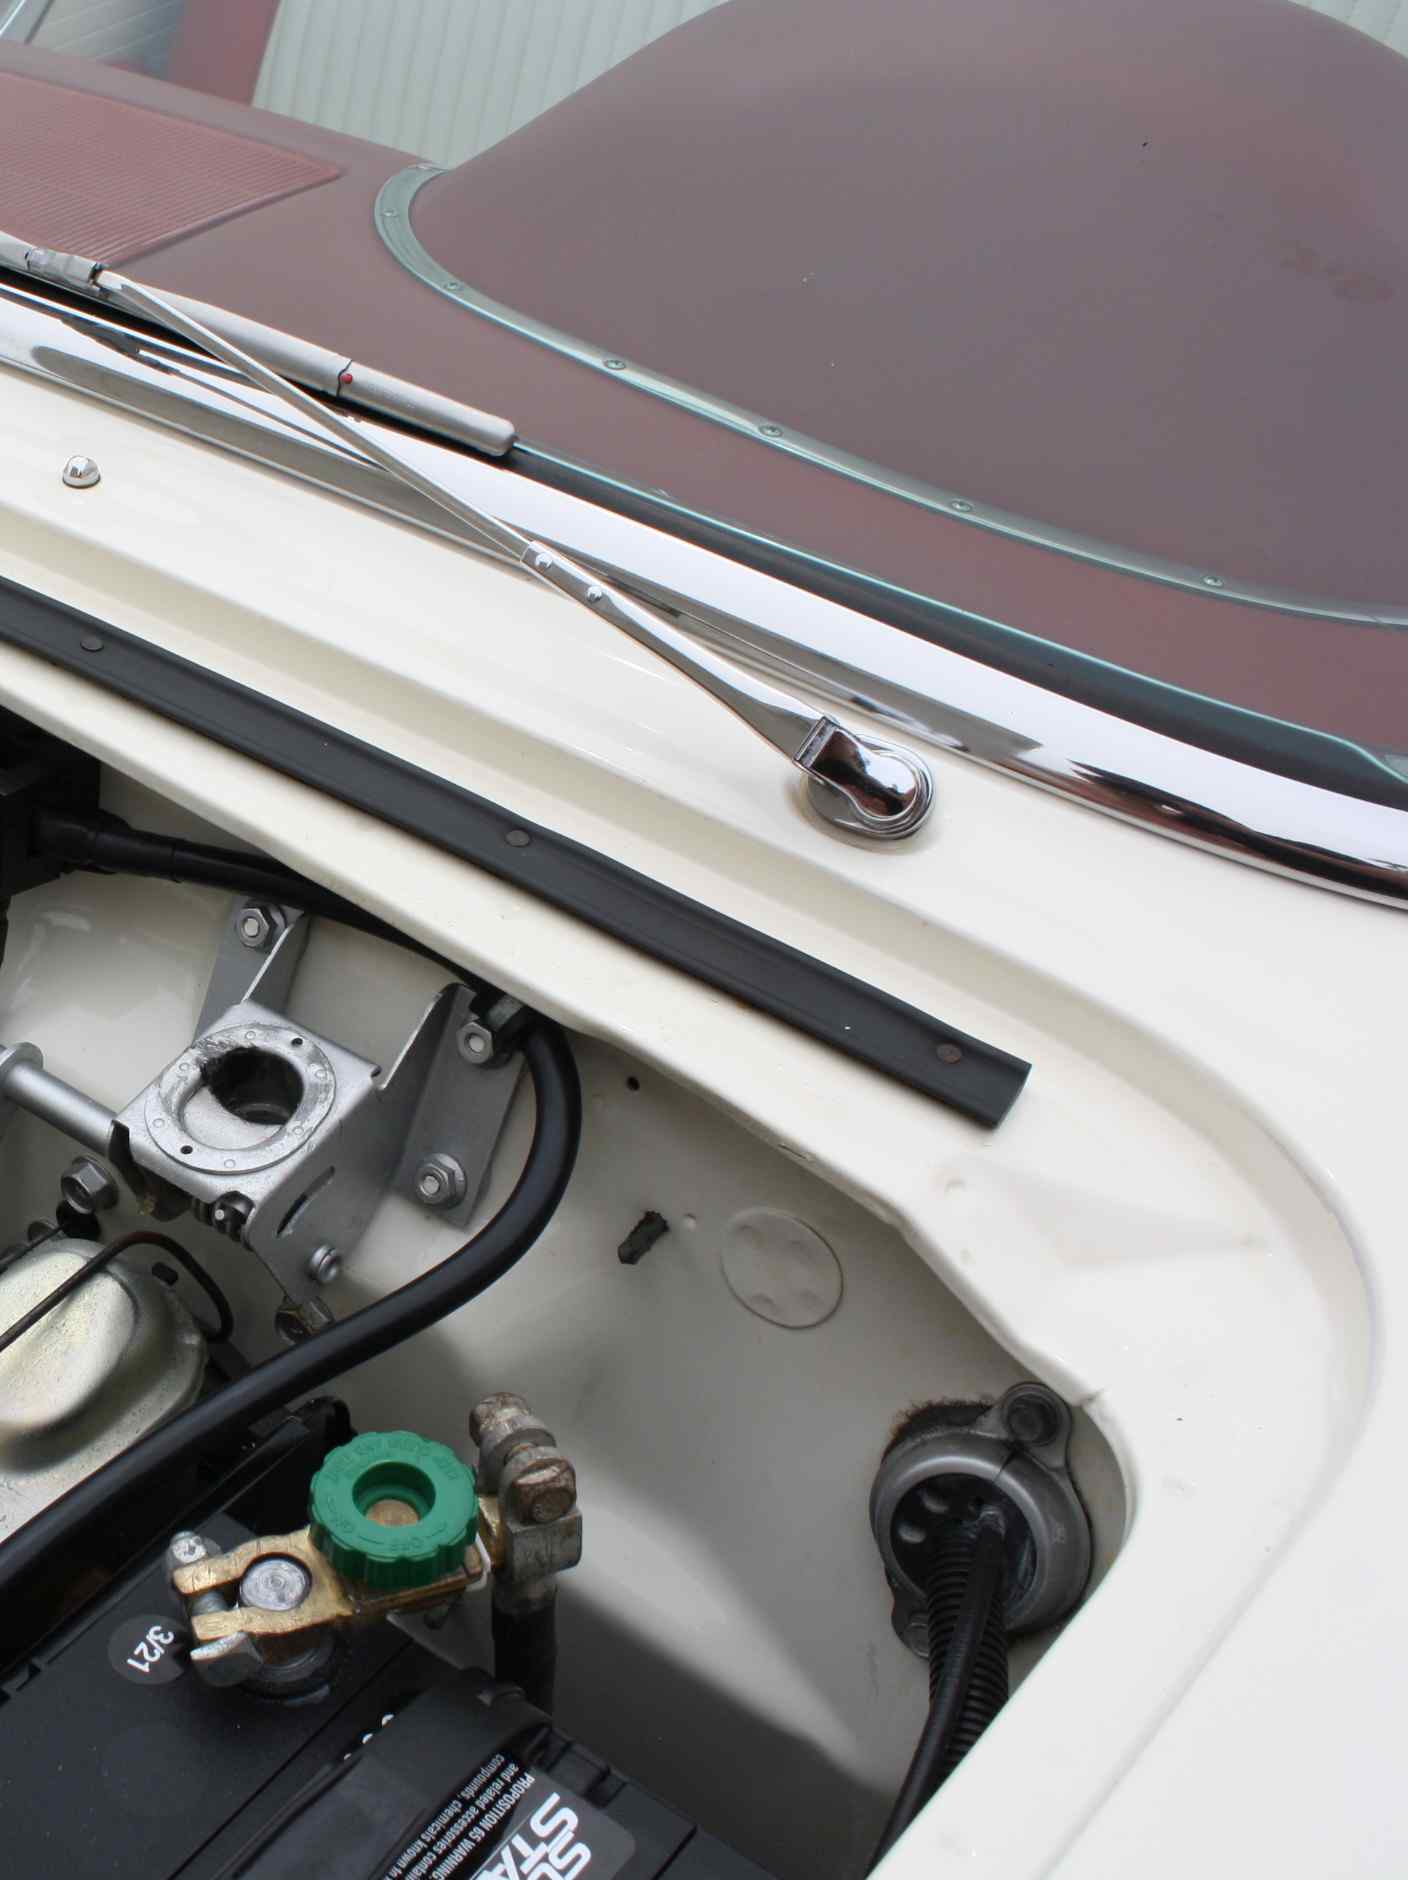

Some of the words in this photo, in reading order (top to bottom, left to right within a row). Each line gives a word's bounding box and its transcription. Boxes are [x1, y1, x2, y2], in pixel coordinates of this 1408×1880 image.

[126, 1625, 174, 1672] 3/21
[500, 1763, 519, 1783] and
[475, 1778, 505, 1810] related
[479, 1772, 535, 1832] PROPOSITION
[420, 1800, 462, 1842] chemicals
[432, 1806, 479, 1855] accessories
[468, 1826, 486, 1841] 65
[396, 1839, 428, 1869] known
